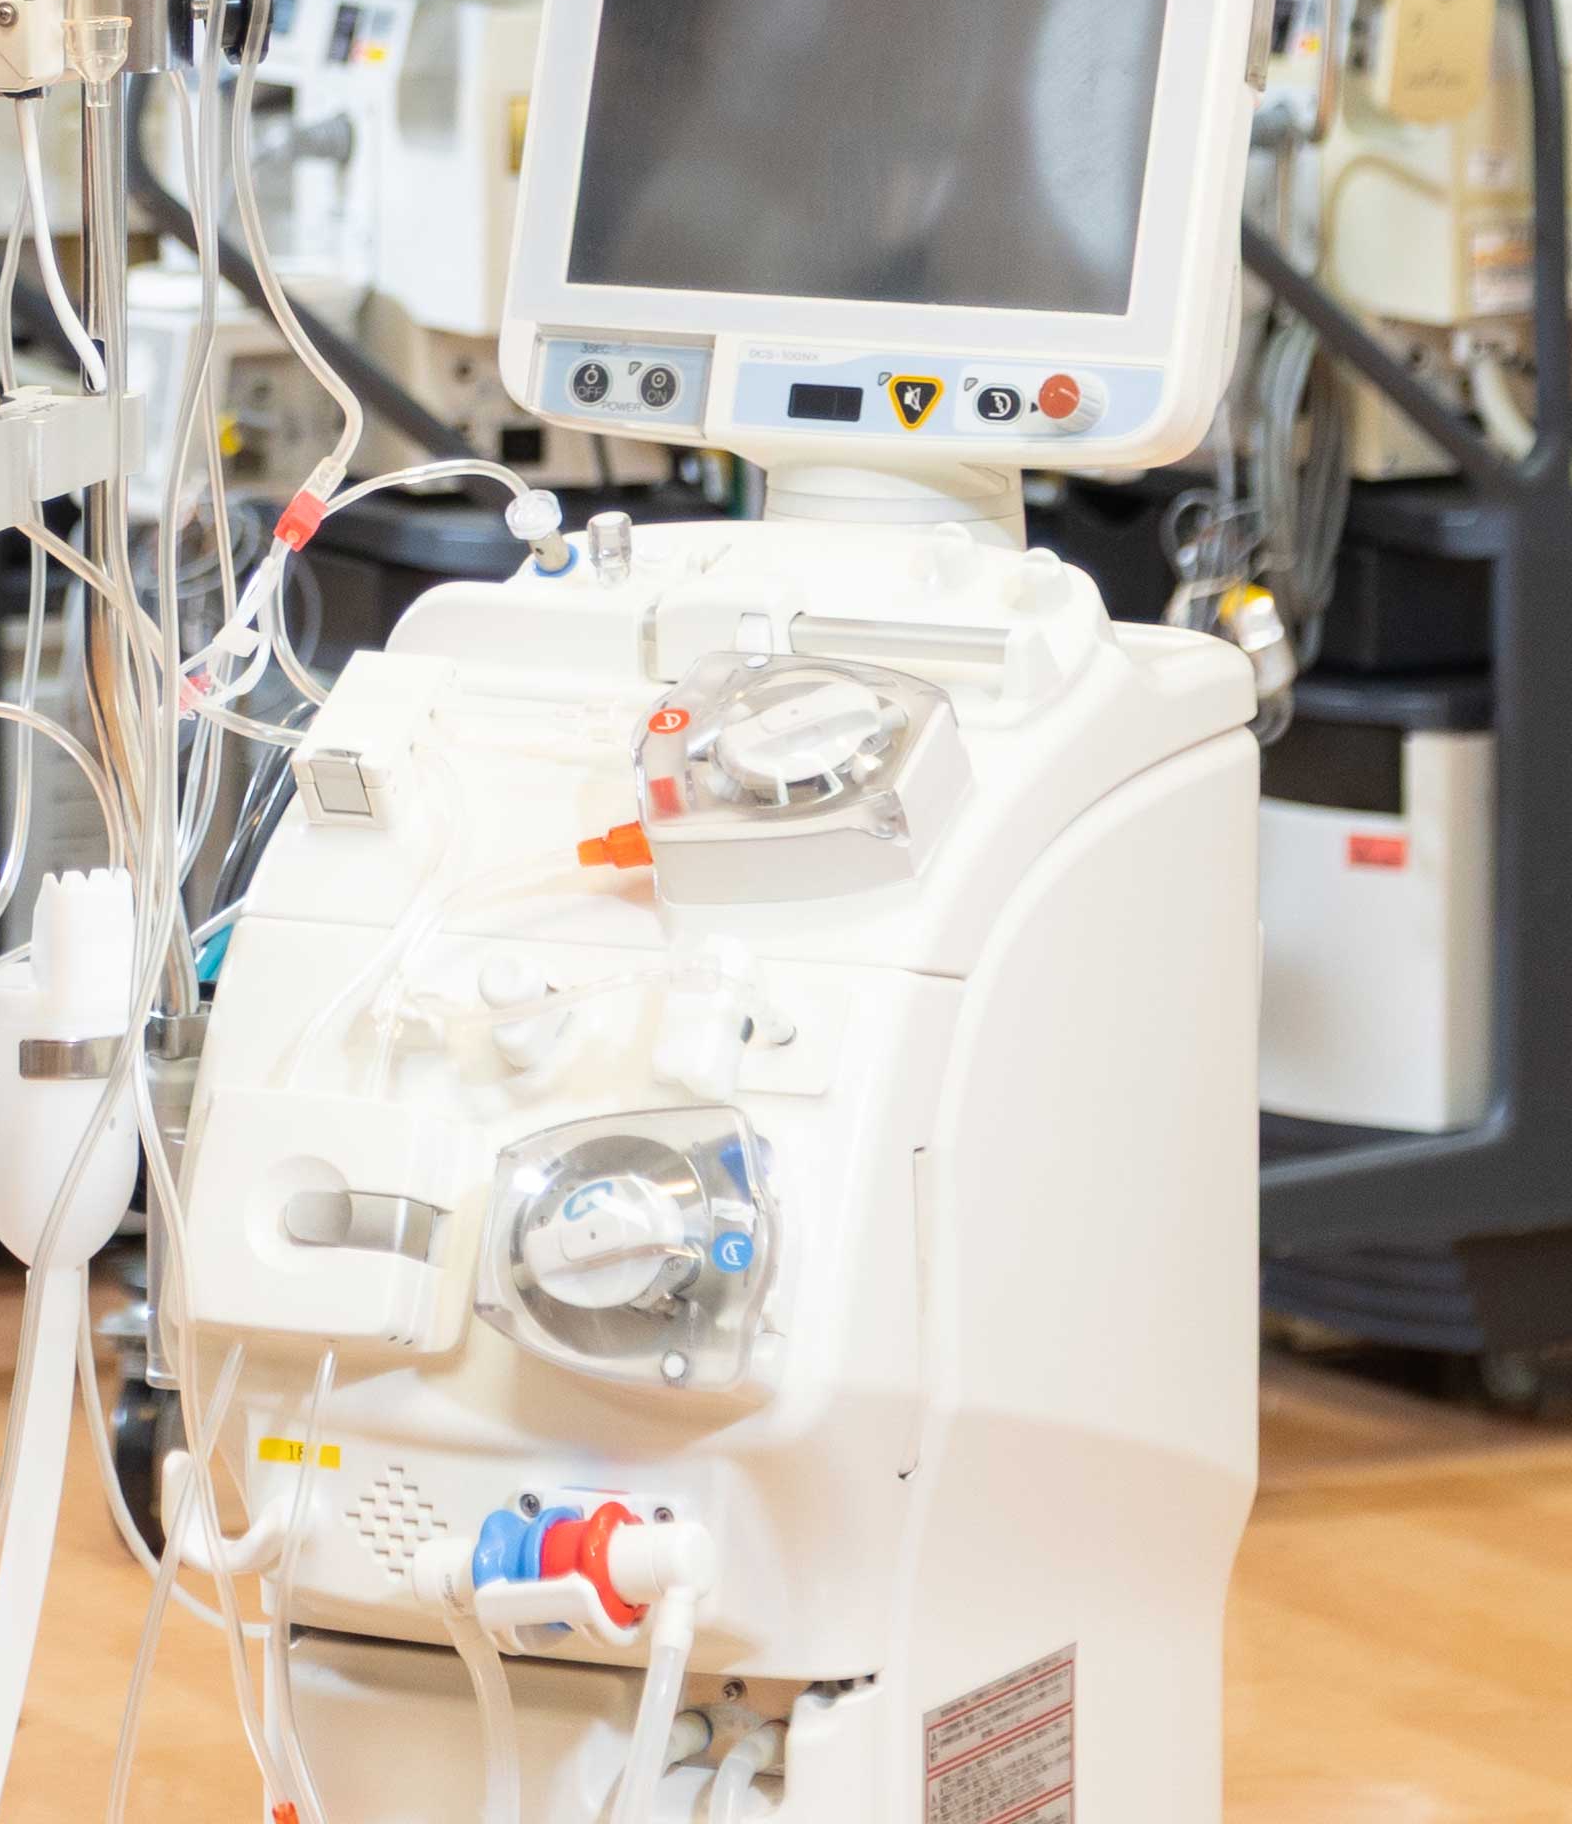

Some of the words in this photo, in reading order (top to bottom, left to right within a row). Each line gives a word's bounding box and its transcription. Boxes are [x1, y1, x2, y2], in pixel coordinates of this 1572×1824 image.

[578, 385, 603, 399] OFF
[646, 389, 668, 404] ON
[601, 401, 642, 413] POWER
